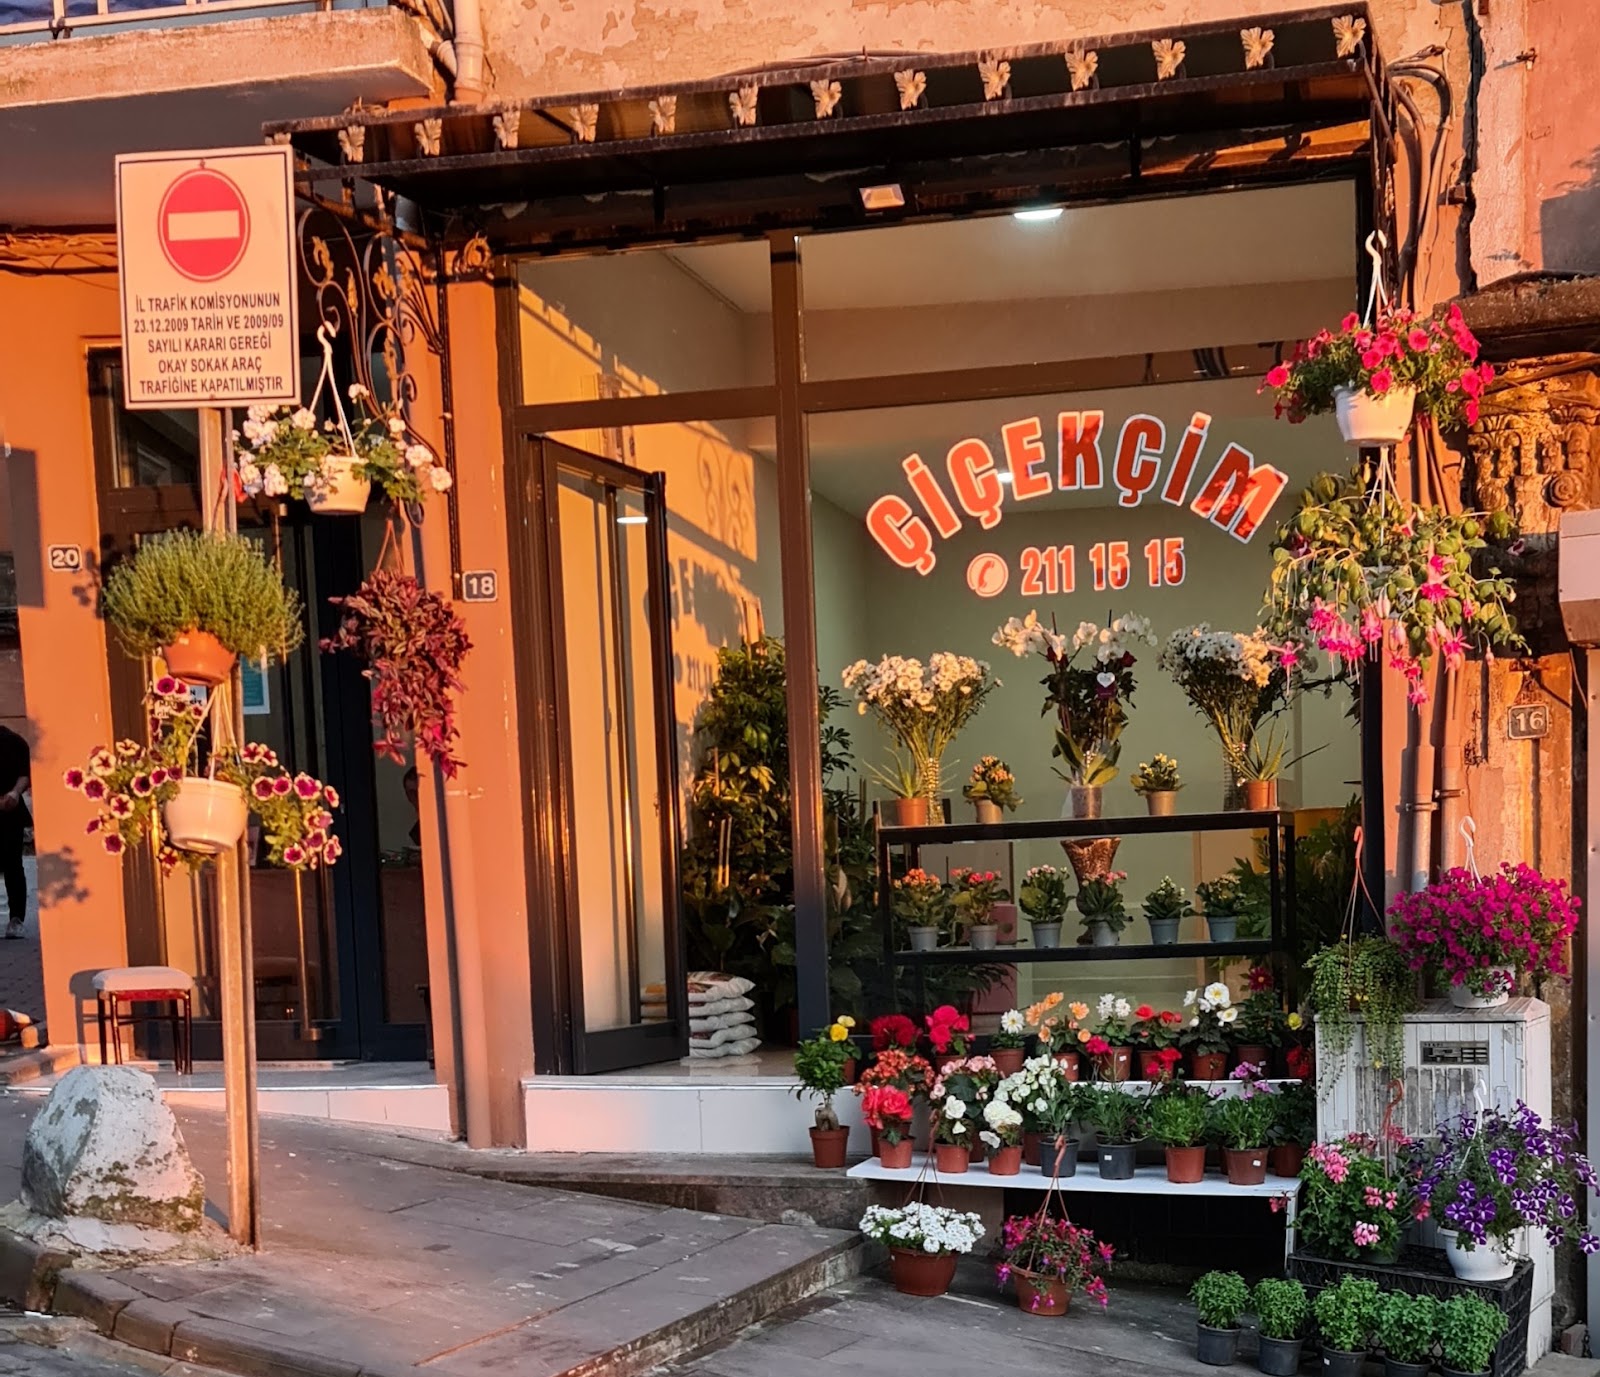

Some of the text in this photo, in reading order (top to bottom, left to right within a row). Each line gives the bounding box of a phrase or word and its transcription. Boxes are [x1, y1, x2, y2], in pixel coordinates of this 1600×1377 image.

[135, 291, 280, 313] İL TRAFİK KOMİSYONUNUN
[134, 313, 284, 333] 23.12.2009 TARİH VE 2009/09
[148, 332, 271, 353] SAYILI KARARI GEREĞİ
[158, 356, 262, 374] OKAY SOKAK ARAÇ
[140, 374, 283, 394] TRAFİĞİNE KAPATILMIŞTIR
[866, 410, 1289, 575] ÇİÇEKÇİM
[52, 549, 79, 567] 20
[1020, 536, 1186, 596] 211 15 15
[469, 576, 494, 595] 18
[1515, 711, 1544, 731] 16
